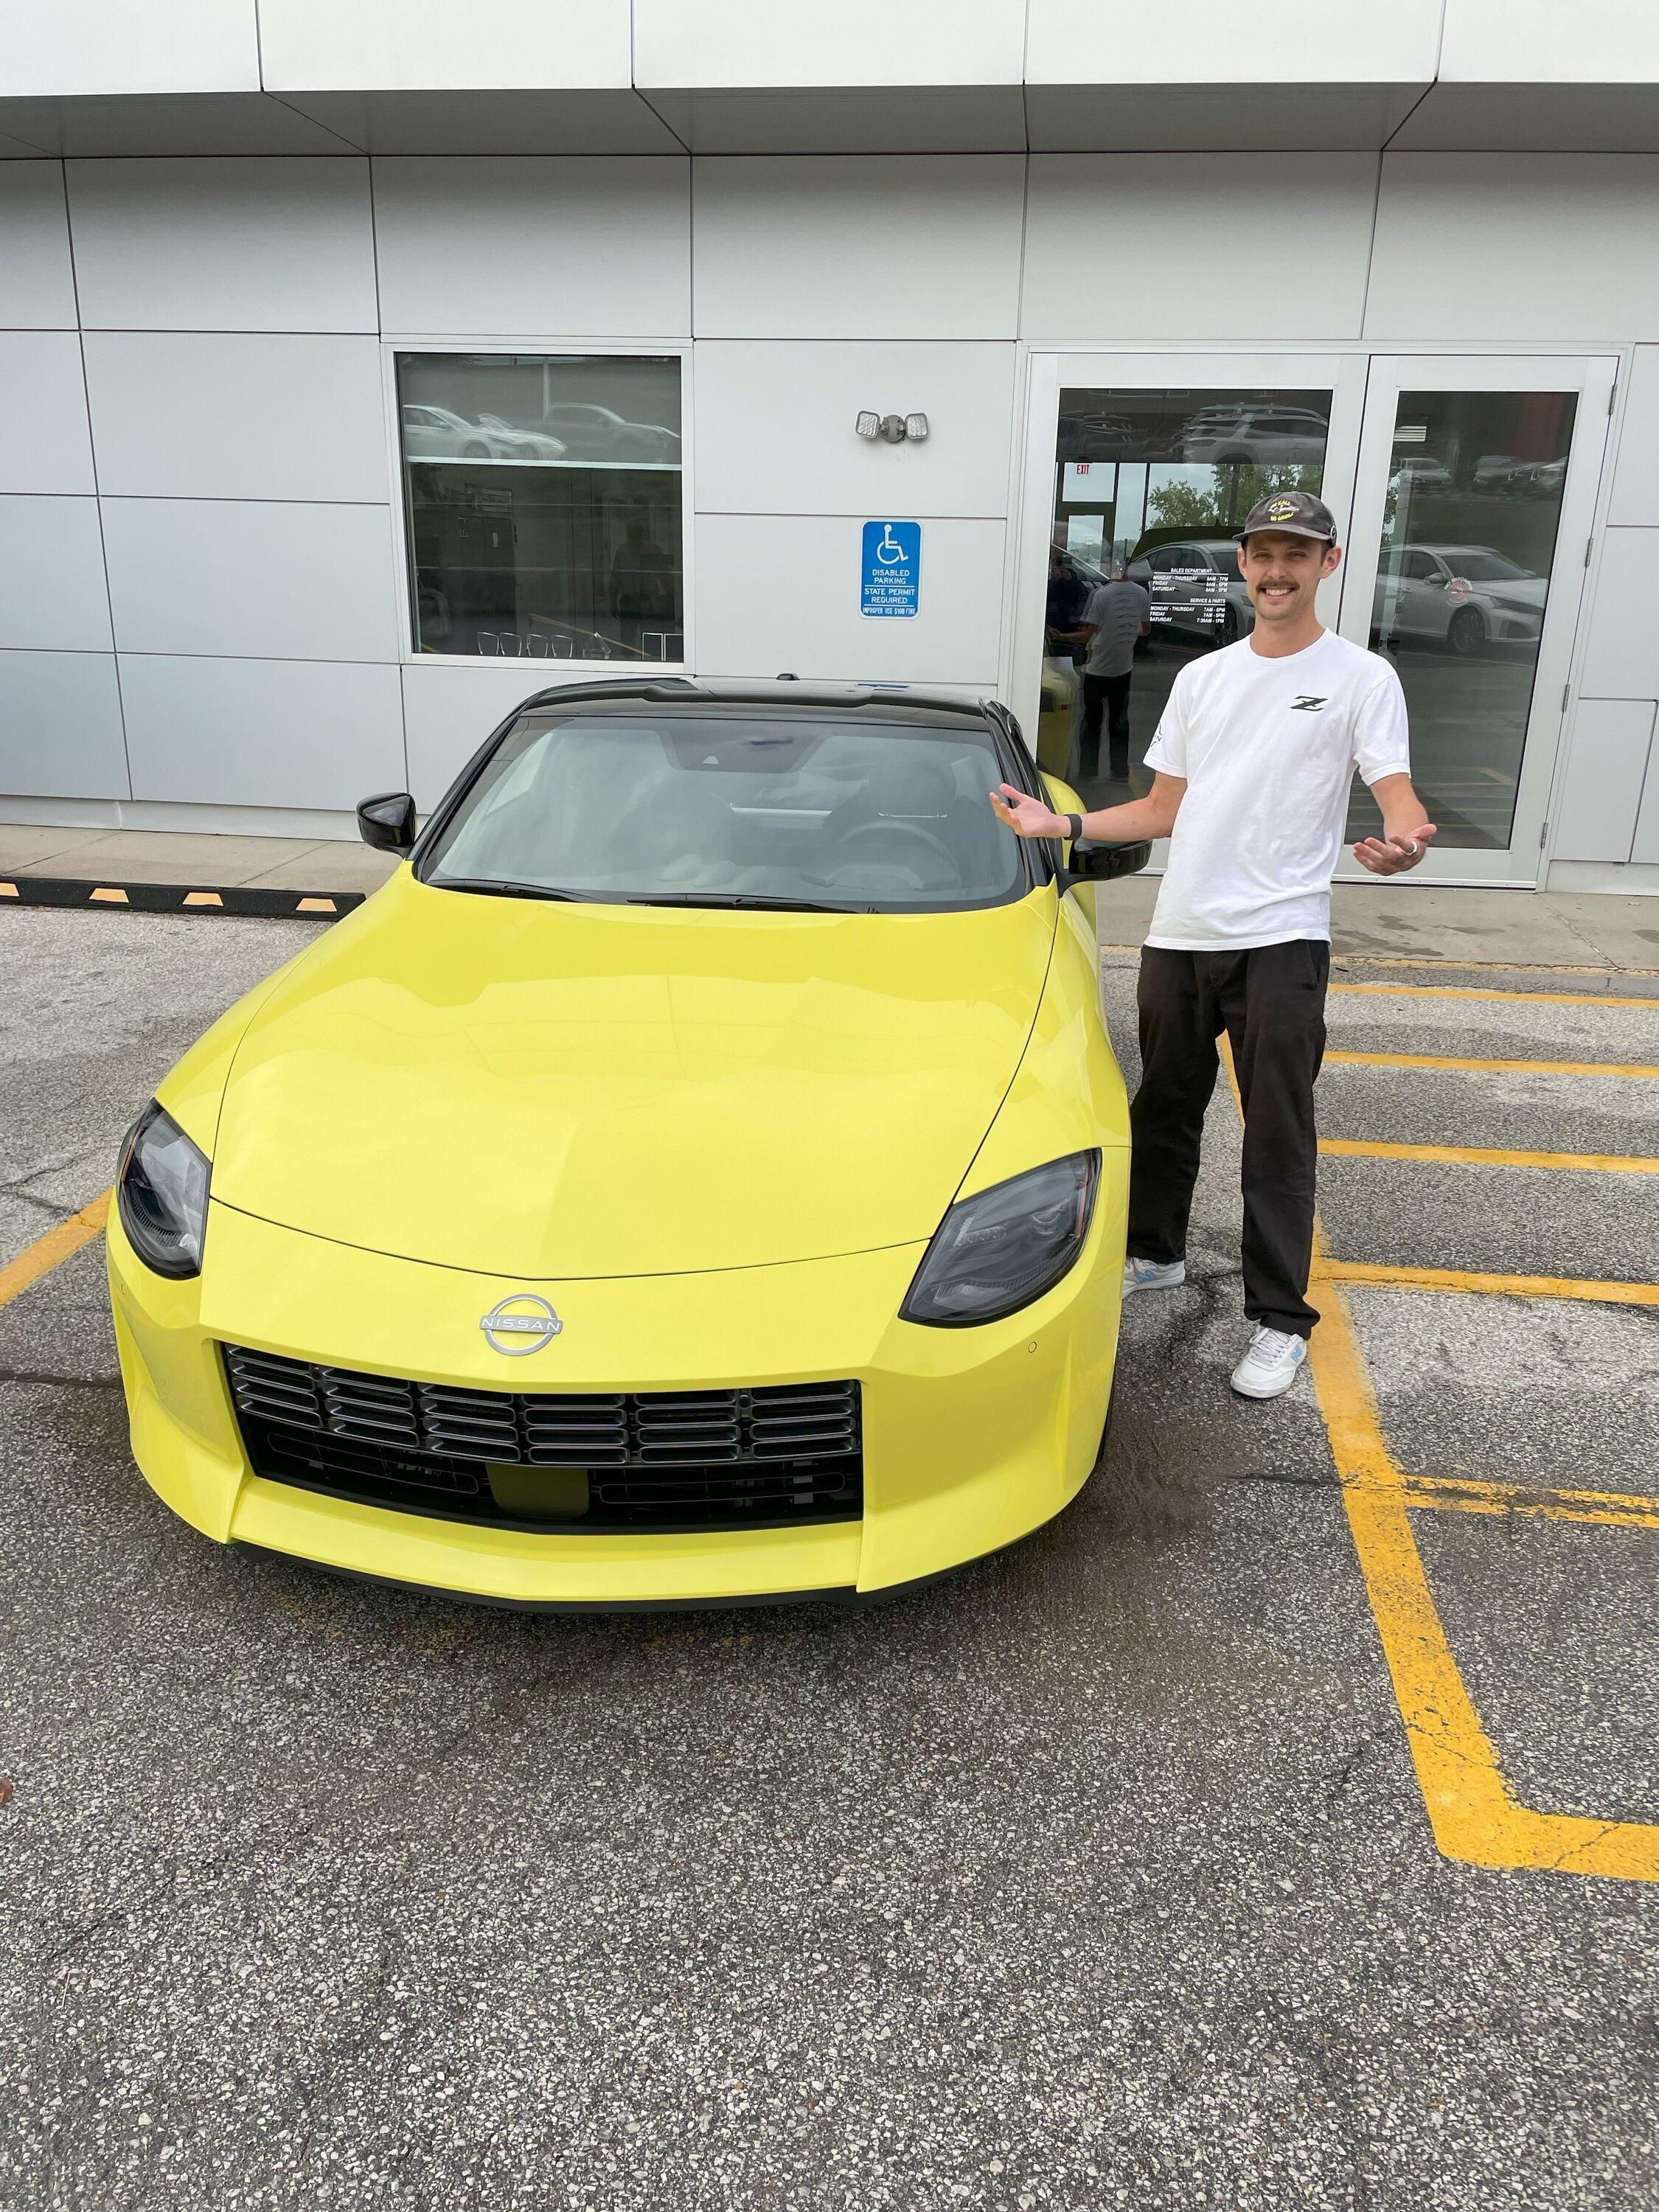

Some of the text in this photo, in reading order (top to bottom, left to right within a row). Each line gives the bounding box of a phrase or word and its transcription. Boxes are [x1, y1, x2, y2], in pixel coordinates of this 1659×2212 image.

[1077, 464, 1090, 474] EXIT
[1444, 581, 1451, 590] NO
[481, 1318, 560, 1331] NISSAN
